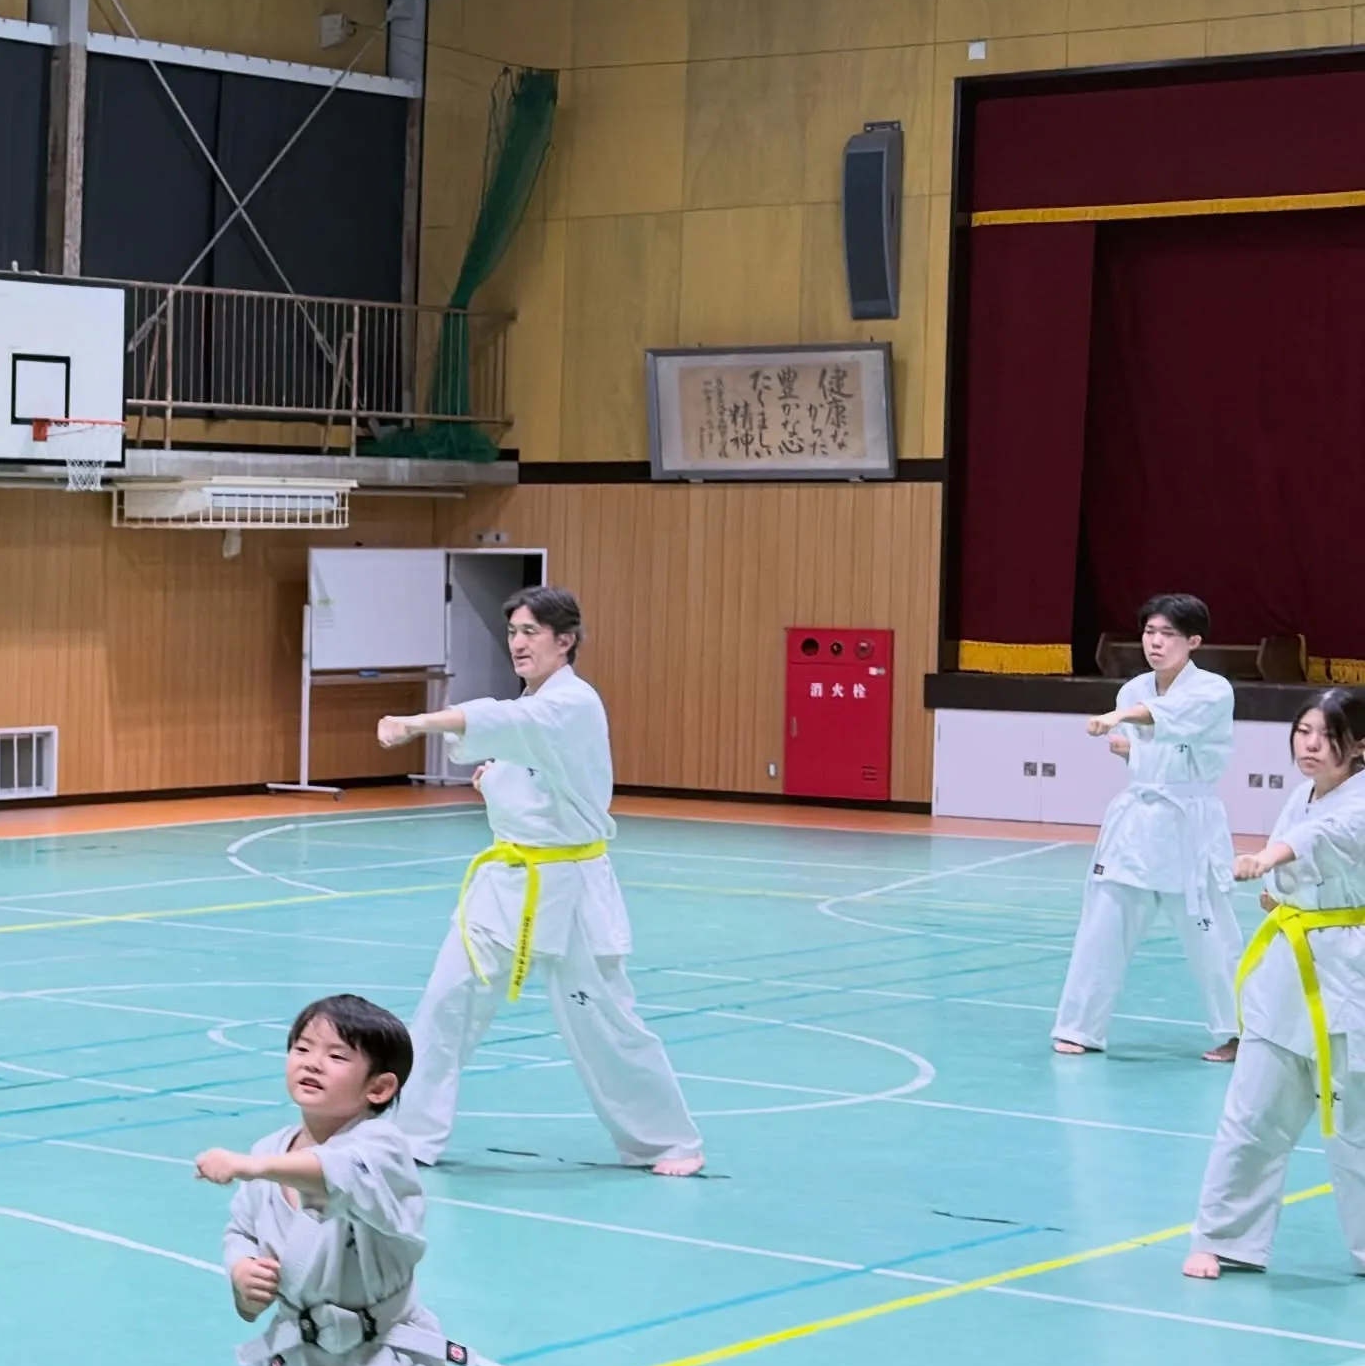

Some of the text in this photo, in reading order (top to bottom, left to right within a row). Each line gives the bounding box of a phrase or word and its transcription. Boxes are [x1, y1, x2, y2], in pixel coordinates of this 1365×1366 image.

[728, 399, 755, 458] 精神
[750, 370, 773, 458] たくましい
[776, 365, 804, 455] 豊かな心
[818, 365, 854, 451] 健康な
[810, 682, 867, 699] 消火栓
